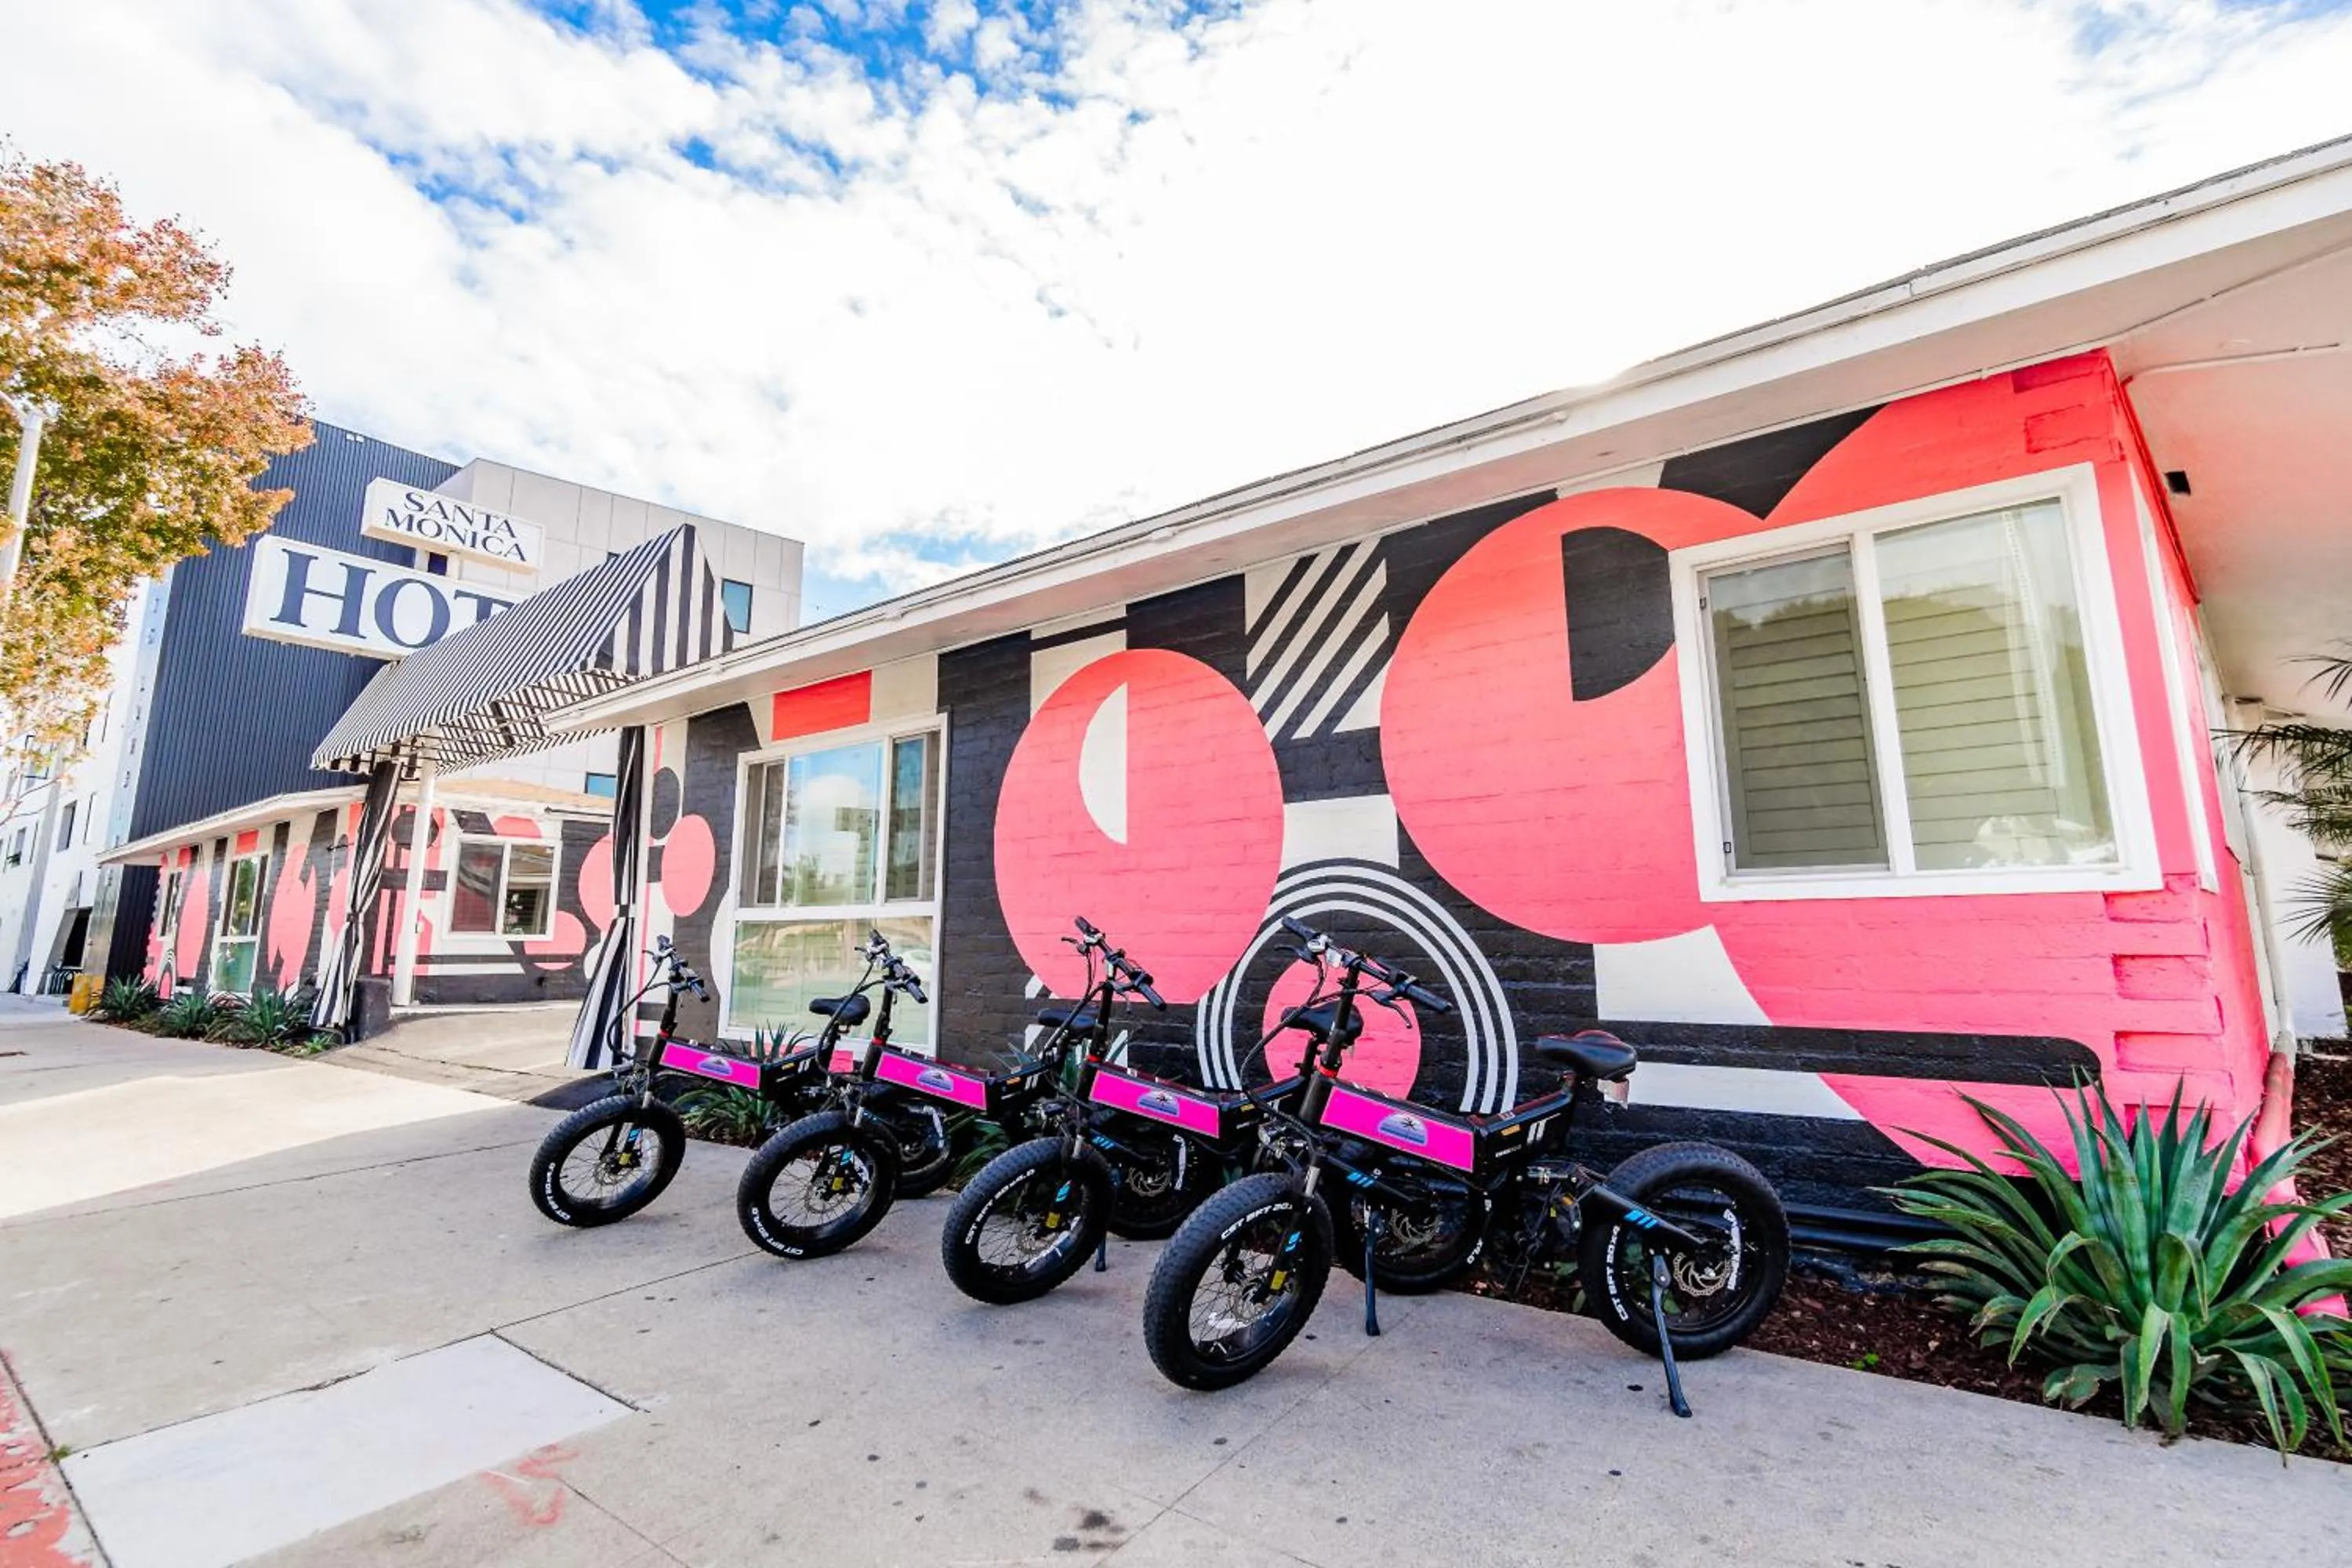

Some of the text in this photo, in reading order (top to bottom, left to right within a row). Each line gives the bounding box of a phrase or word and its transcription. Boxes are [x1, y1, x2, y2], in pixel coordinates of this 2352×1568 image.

[385, 508, 528, 562] MONICA
[405, 492, 517, 538] SANTA
[269, 548, 516, 649] HOT
[1606, 1225, 1621, 1265] 20x4
